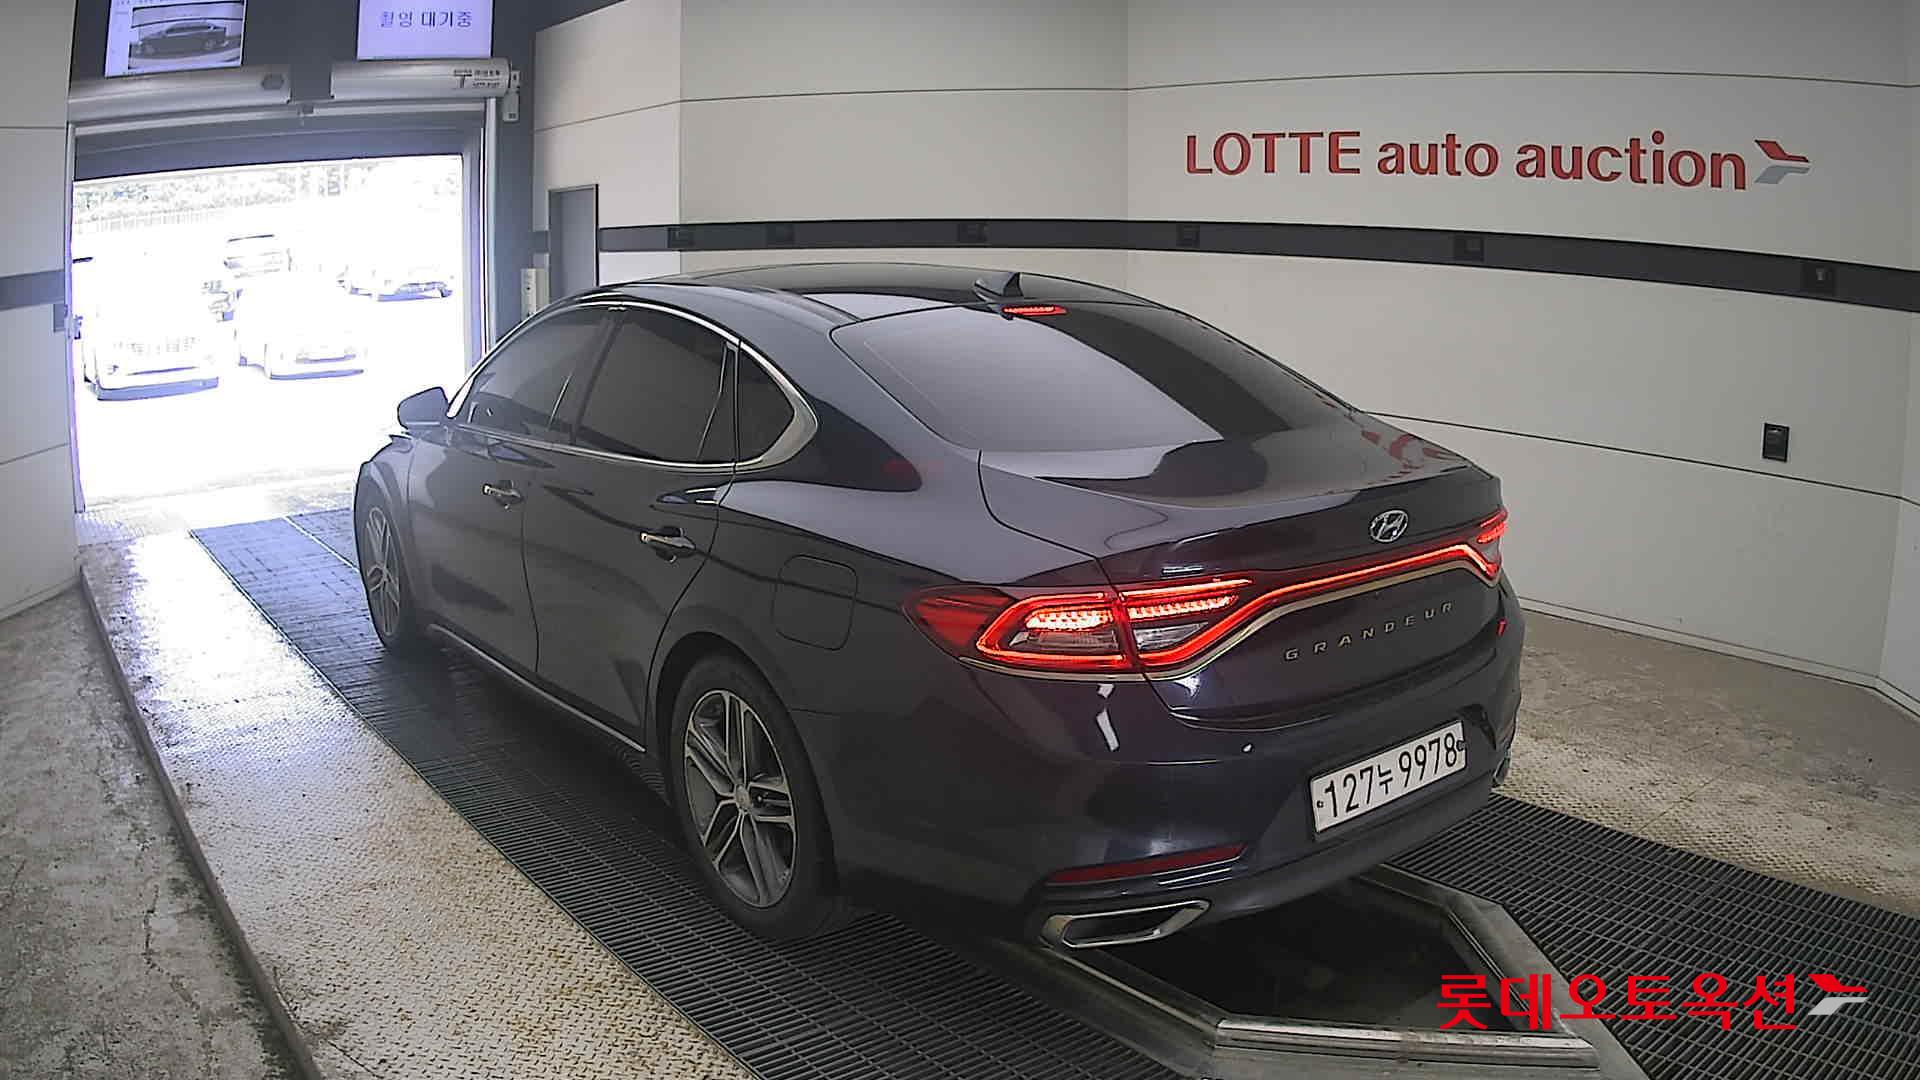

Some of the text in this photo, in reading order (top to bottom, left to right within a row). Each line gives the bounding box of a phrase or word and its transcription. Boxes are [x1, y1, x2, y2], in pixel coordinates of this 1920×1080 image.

[421, 10, 472, 28] 대기중
[1186, 130, 1747, 191] LOTTE auto auction
[1285, 602, 1453, 661] GRANDEUR
[1324, 731, 1457, 818] 127누9978
